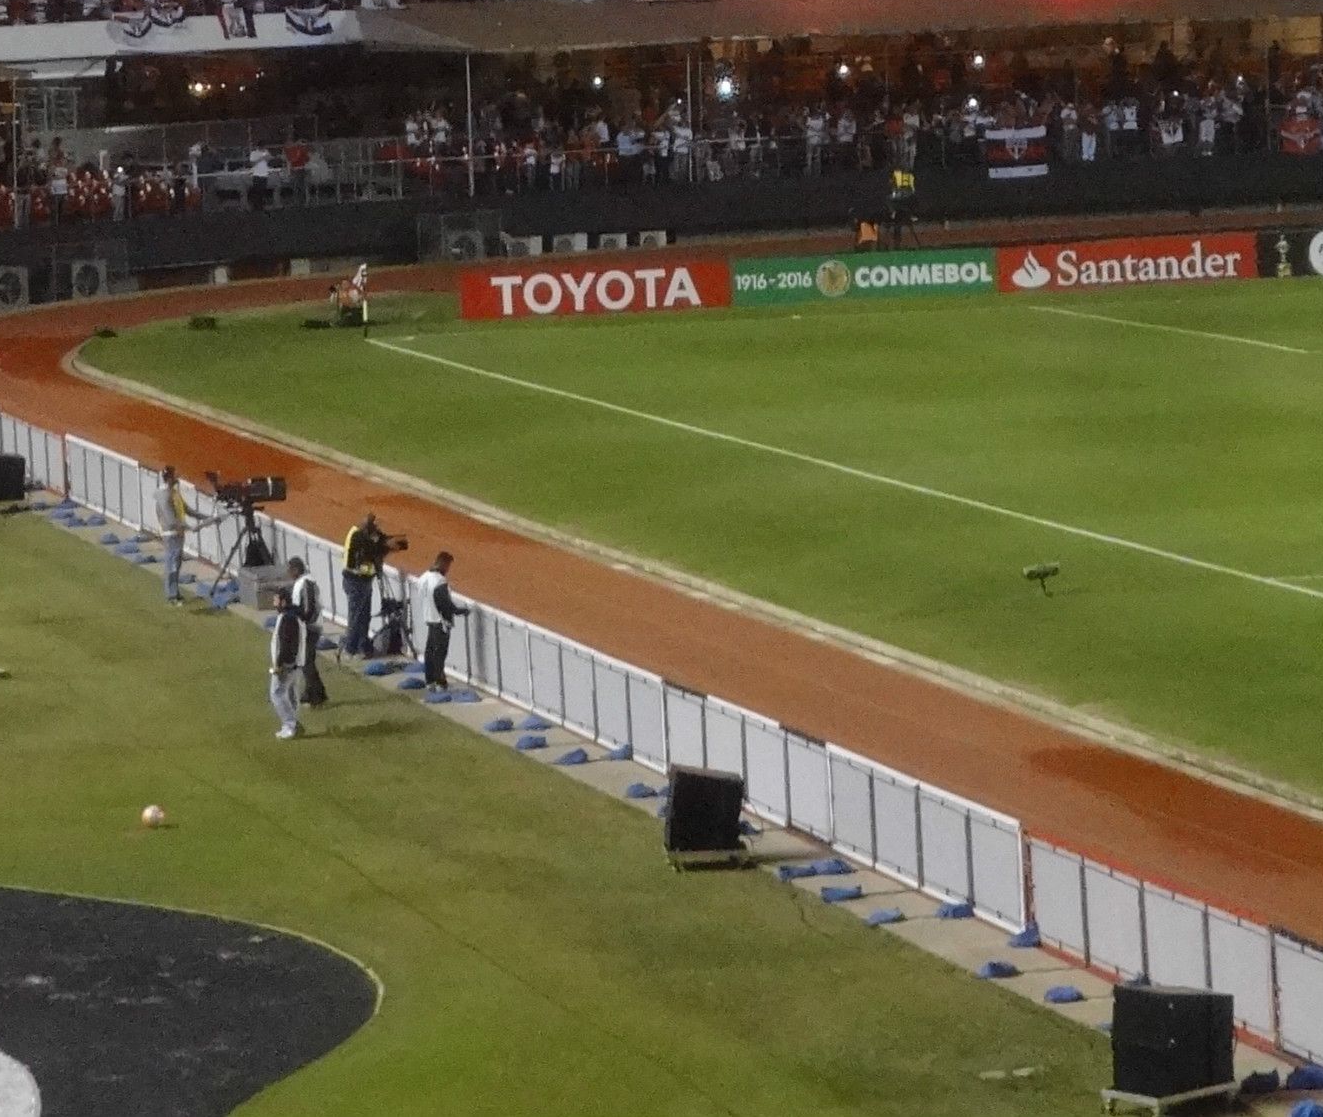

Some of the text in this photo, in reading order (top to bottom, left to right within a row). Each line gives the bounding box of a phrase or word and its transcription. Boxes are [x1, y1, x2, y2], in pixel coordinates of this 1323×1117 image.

[735, 270, 813, 292] 1916-2016
[854, 261, 993, 288] CONMEBOL
[1056, 240, 1241, 286] Santander
[490, 267, 702, 316] TOYOTA
